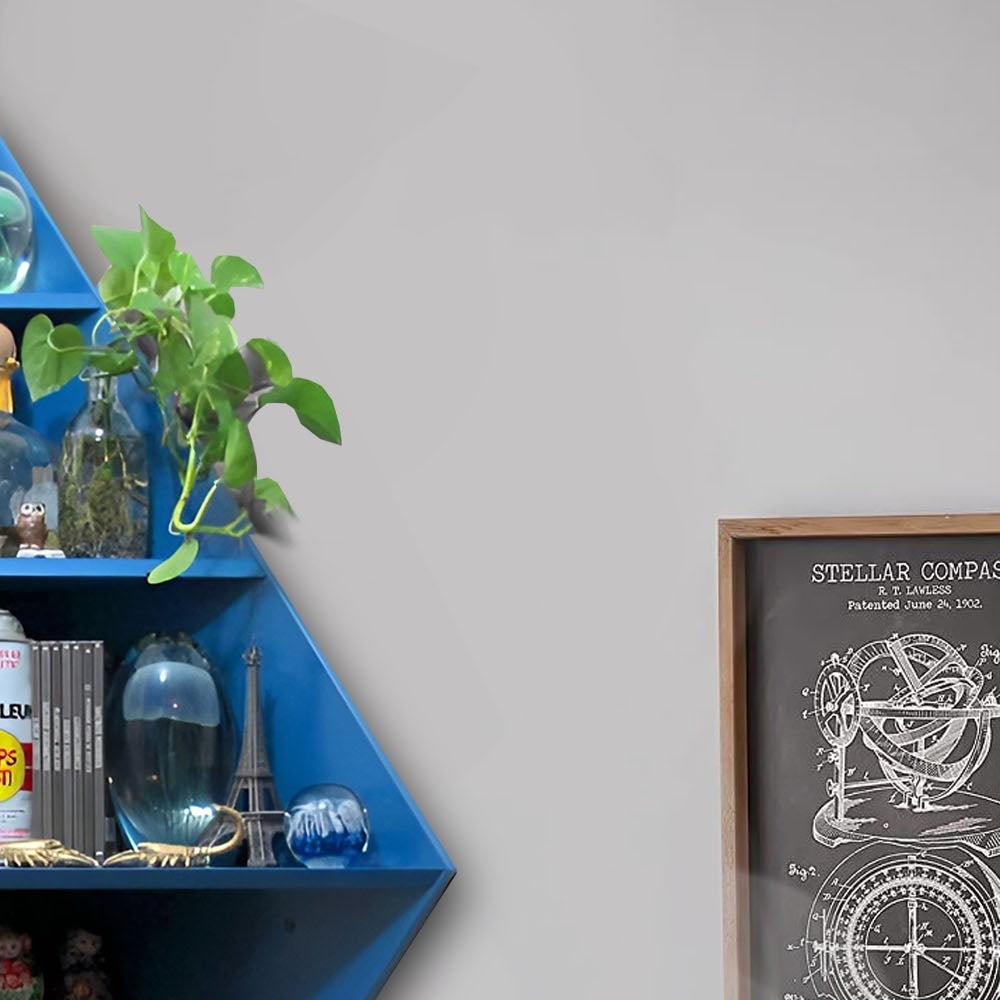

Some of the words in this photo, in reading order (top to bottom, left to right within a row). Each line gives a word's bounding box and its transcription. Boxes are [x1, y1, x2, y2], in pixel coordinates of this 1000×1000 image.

[811, 563, 911, 583] STELLAR
[878, 586, 888, 596] R.
[892, 585, 902, 596] T.
[906, 584, 952, 595] LAWLESS
[848, 600, 900, 610] Patented
[904, 600, 933, 610] June
[955, 599, 983, 609] 1902.
